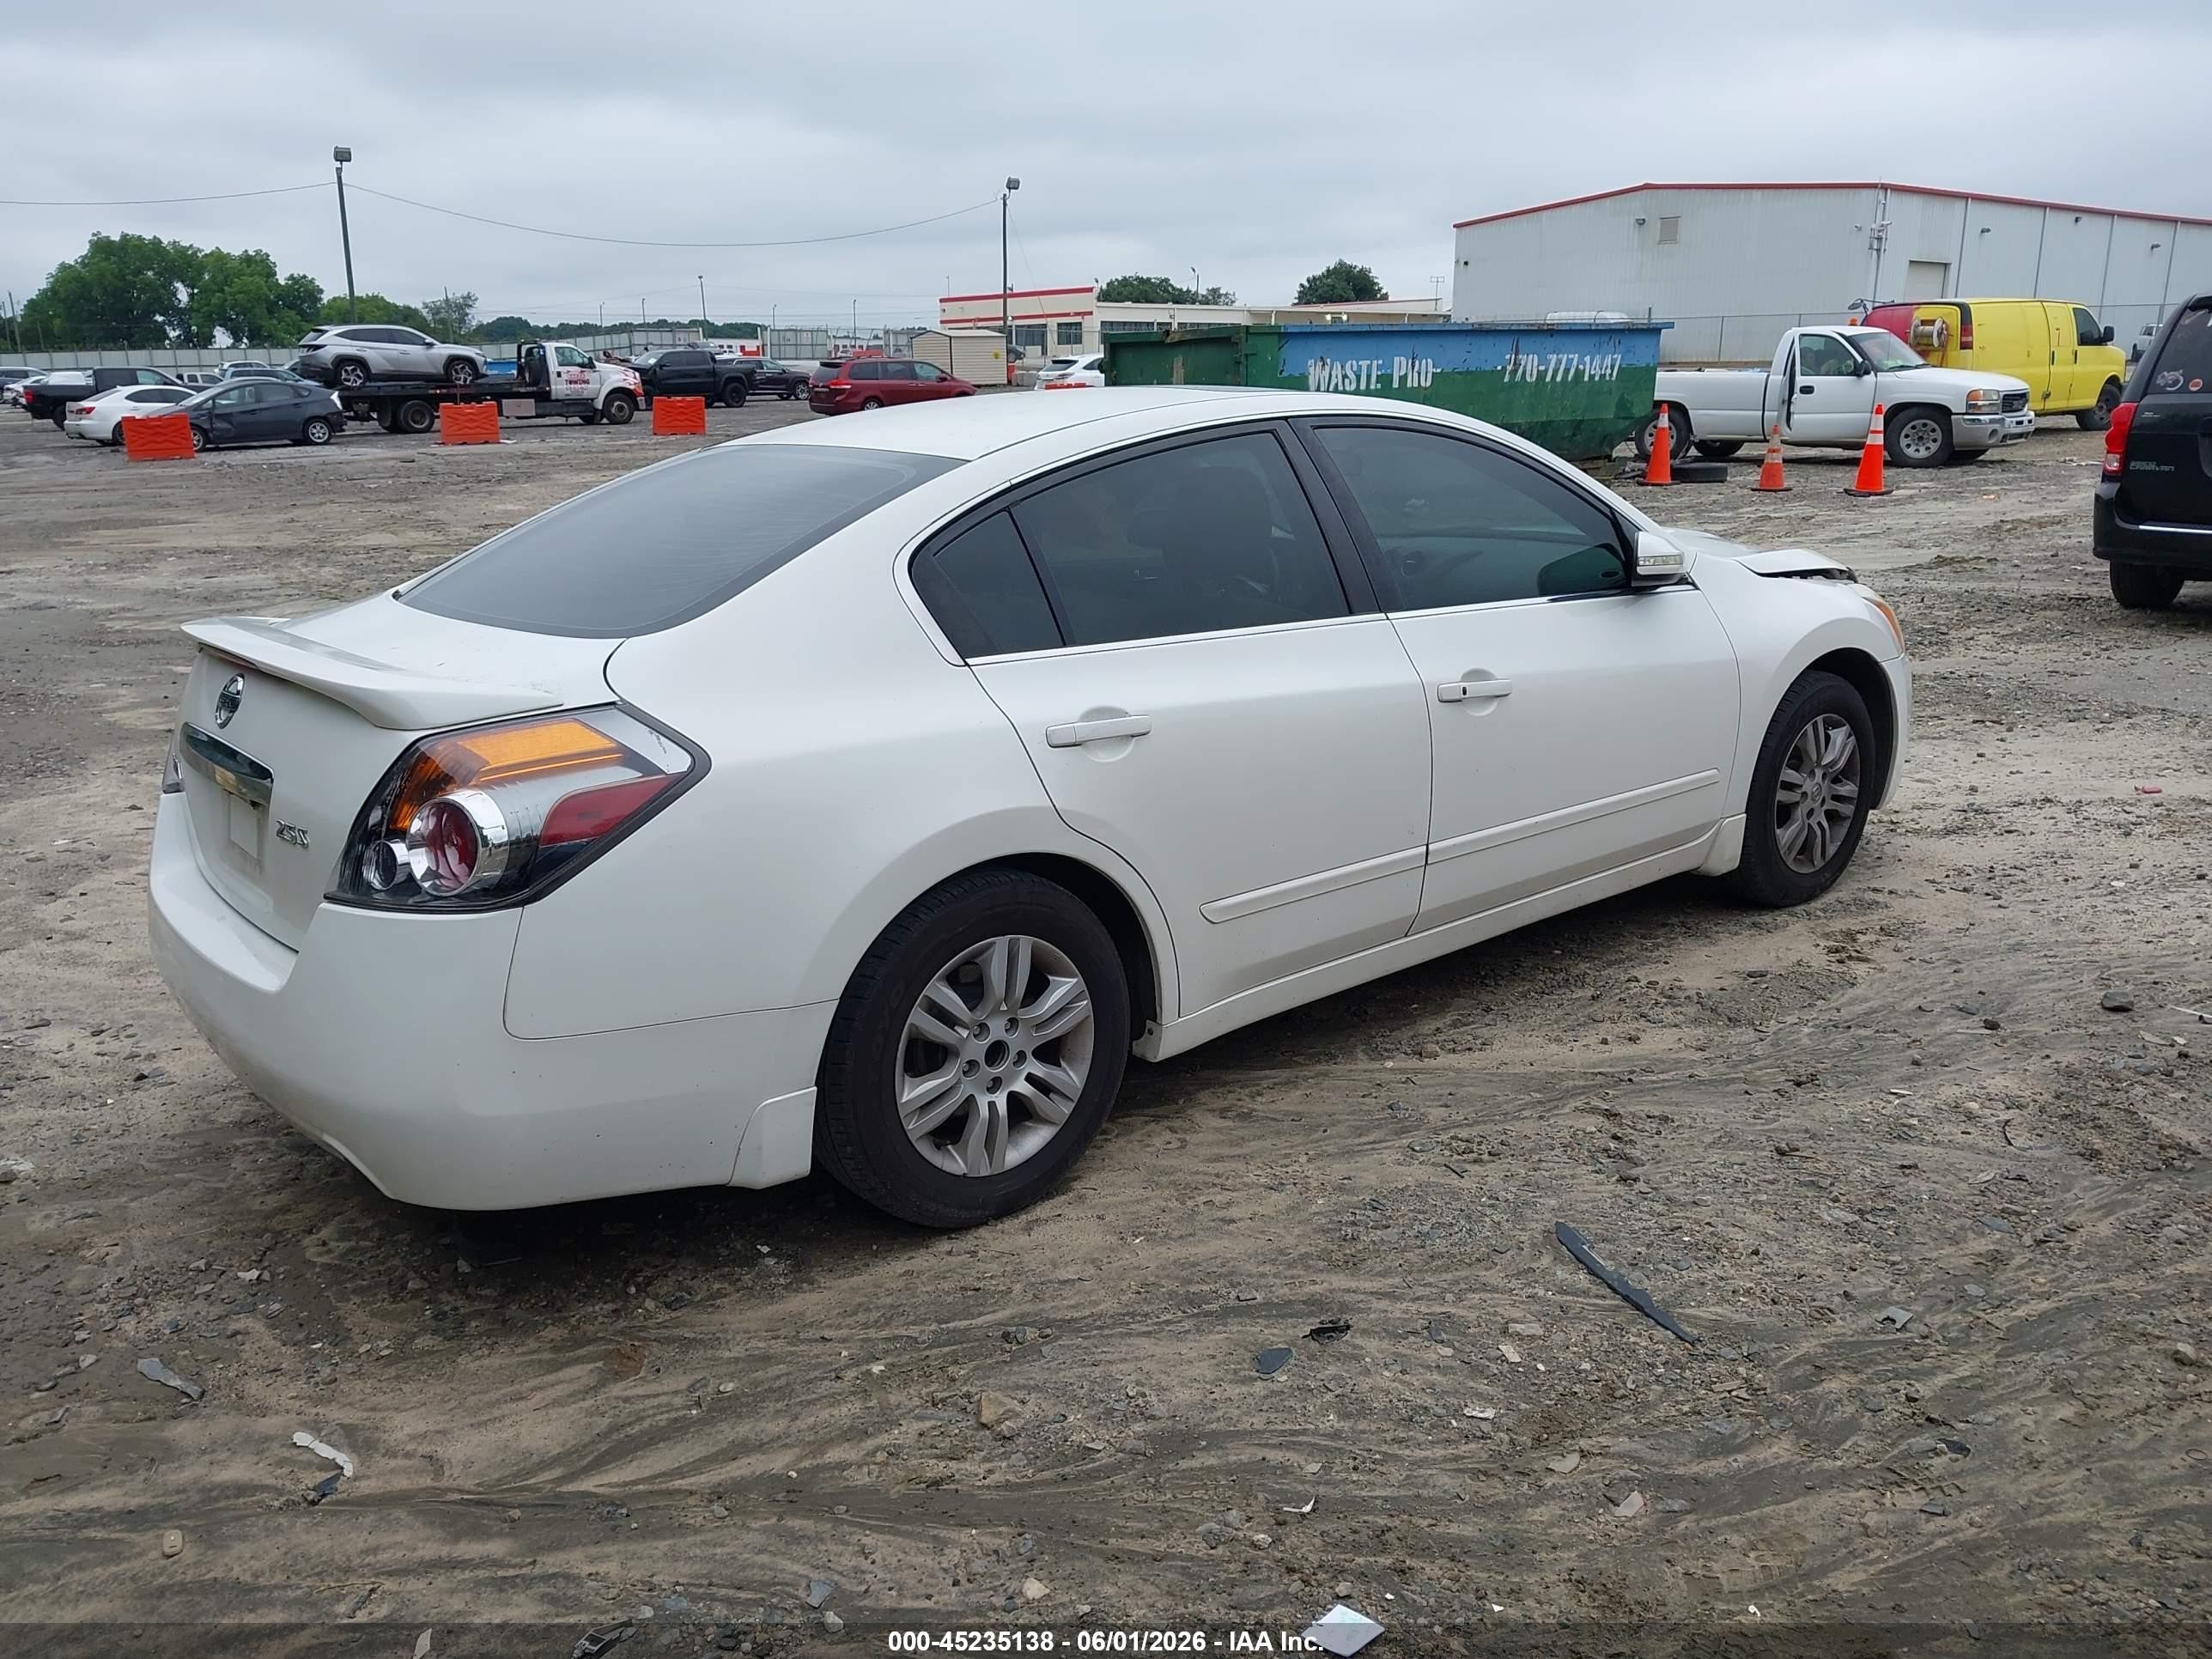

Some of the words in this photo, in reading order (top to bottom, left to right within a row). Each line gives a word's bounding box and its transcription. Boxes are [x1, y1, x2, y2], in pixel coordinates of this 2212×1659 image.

[1308, 358, 1382, 392] WASTE
[1393, 356, 1433, 388] PRO
[1504, 354, 1621, 382] 770-777-1447
